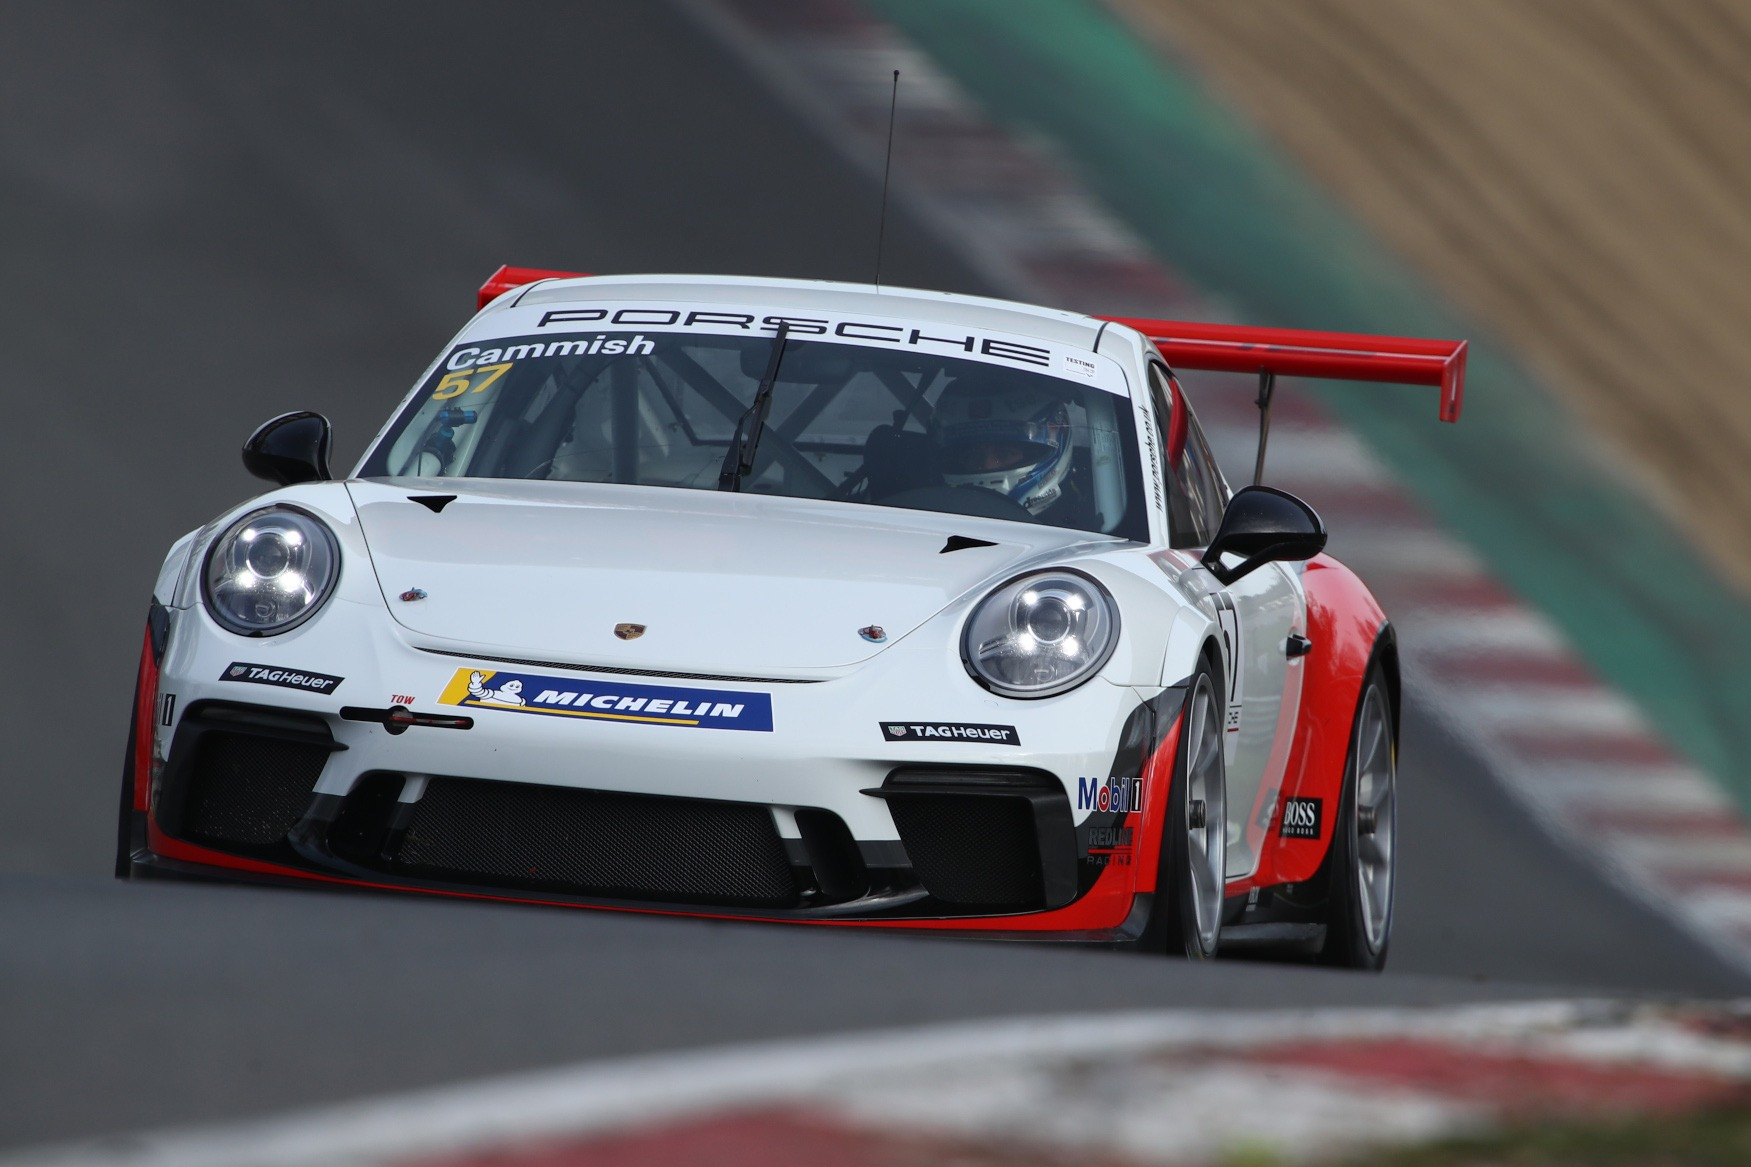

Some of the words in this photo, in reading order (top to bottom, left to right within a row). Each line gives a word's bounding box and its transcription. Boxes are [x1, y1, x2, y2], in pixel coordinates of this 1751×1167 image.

[446, 335, 656, 371] Cammish
[537, 309, 1050, 367] PORSCHE
[1065, 356, 1096, 369] TESTING
[432, 362, 514, 400] 57
[390, 694, 416, 705] TOW
[532, 690, 745, 718] MICHELIN
[1078, 777, 1130, 813] Mobil
[1284, 801, 1315, 827] BOSS
